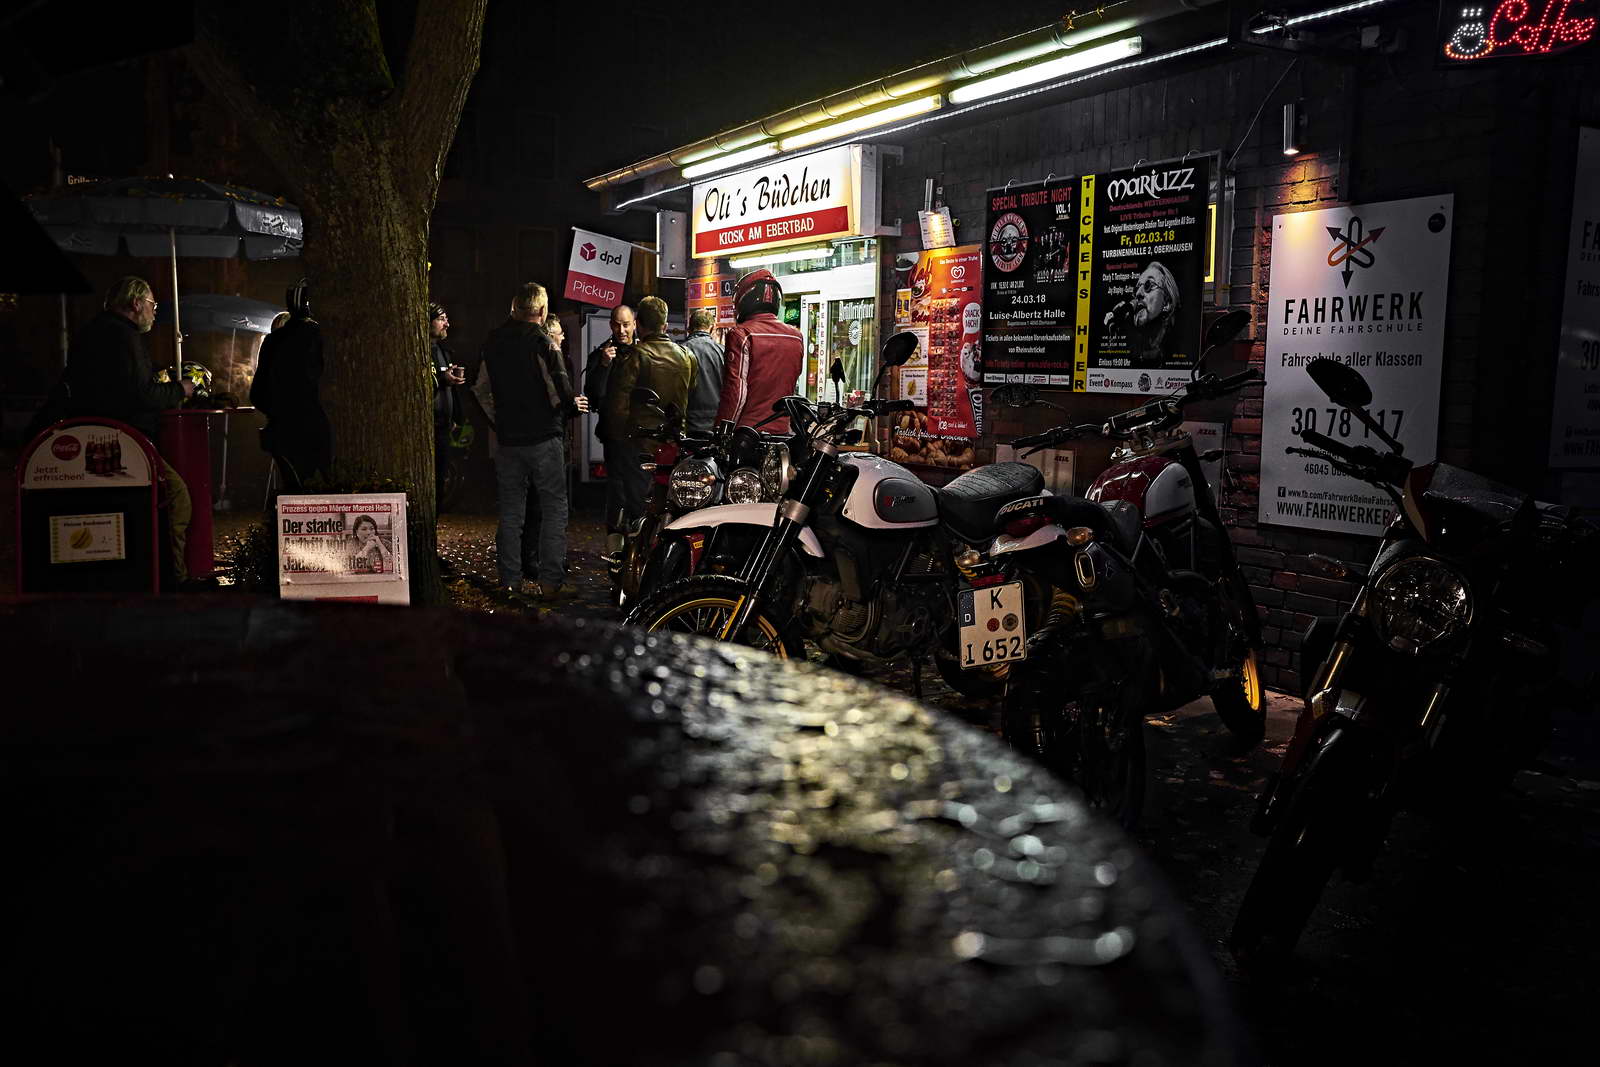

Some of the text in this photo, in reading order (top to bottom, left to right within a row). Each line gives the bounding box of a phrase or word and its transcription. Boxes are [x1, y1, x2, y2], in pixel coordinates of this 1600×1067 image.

[1490, 0, 1595, 51] Coffee
[754, 166, 831, 211] Büdchen
[992, 187, 1072, 211] SPECIAL TRIBUTE NIGHT
[719, 218, 815, 245] KIOSK AM EBERTBAD
[1080, 178, 1094, 300] TICKETS
[1134, 230, 1176, 244] 02.03.18
[600, 251, 622, 265] dpd
[1102, 247, 1146, 259] TURBINENHALLE
[1154, 242, 1194, 254] OBERHAUSEN
[573, 280, 617, 302] Pickup
[1011, 294, 1046, 304] 24.03.18
[989, 309, 1066, 320] Luise-Albertz Halle
[1284, 291, 1424, 325] FAHRWERK
[1284, 322, 1424, 337] DEINE FAHRSCHULE
[1074, 325, 1088, 390] HIER
[1345, 352, 1371, 367] aller
[1375, 351, 1424, 367] Klassen
[1089, 378, 1103, 388] Event
[1291, 407, 1316, 436] 30
[1326, 408, 1352, 438] 78
[1304, 463, 1329, 476] 46045
[282, 504, 307, 513] Prozess
[1000, 497, 1044, 515] DUCATI
[283, 517, 343, 534] Der starke
[989, 587, 1003, 609] K
[965, 613, 972, 623] D
[982, 636, 1021, 662] 652
